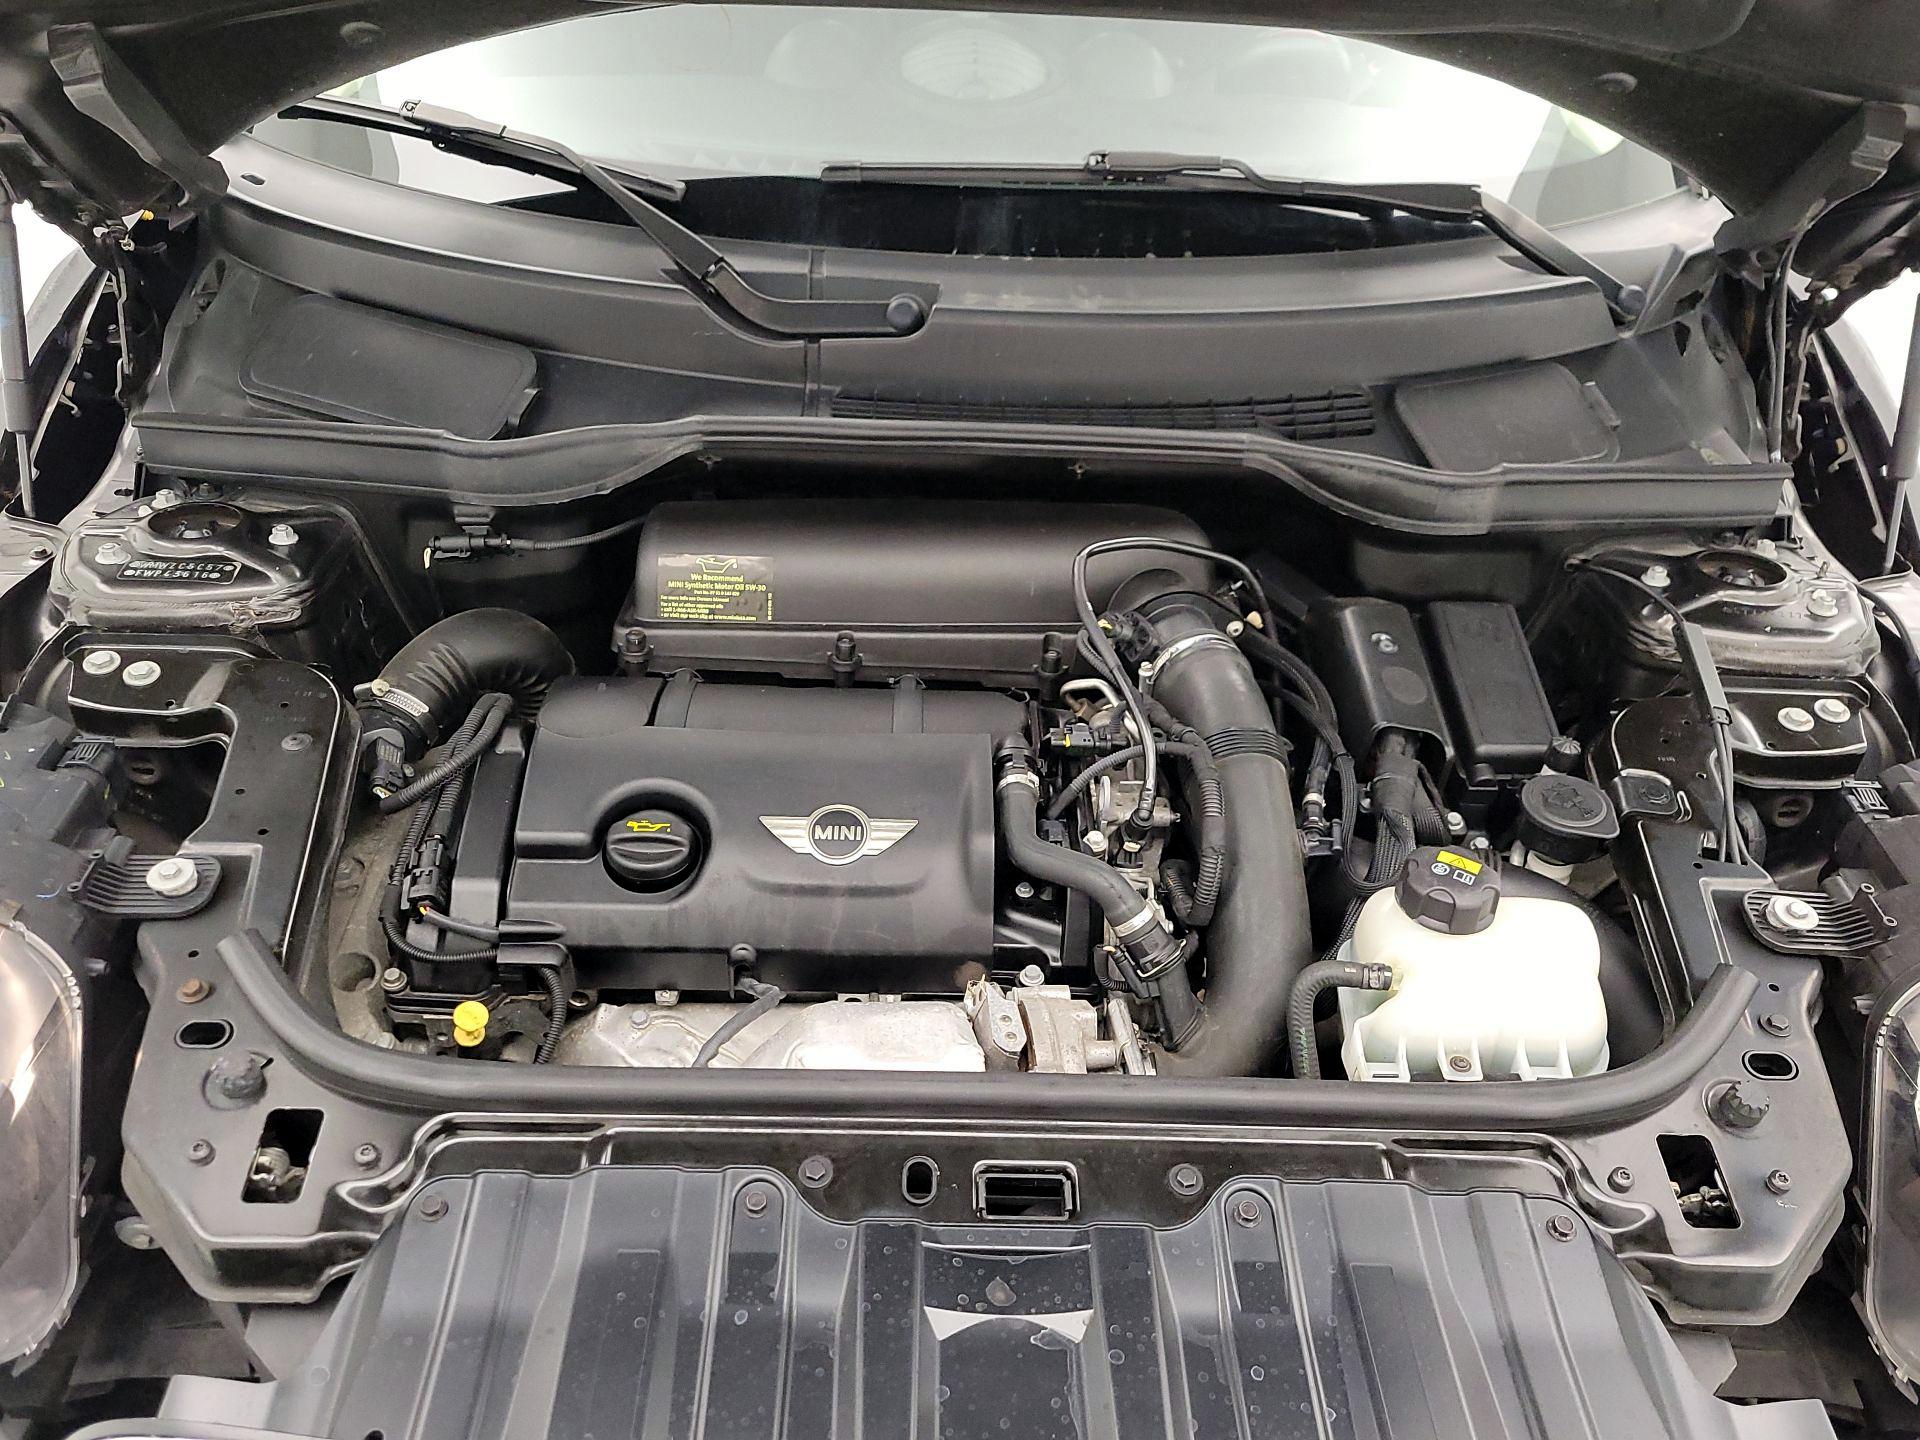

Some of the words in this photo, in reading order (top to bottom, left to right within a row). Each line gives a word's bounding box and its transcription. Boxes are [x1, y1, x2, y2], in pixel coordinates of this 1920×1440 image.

[690, 573, 702, 581] We
[703, 574, 744, 582] Recommend
[684, 582, 714, 590] Synthetic
[814, 825, 862, 841] MINI
